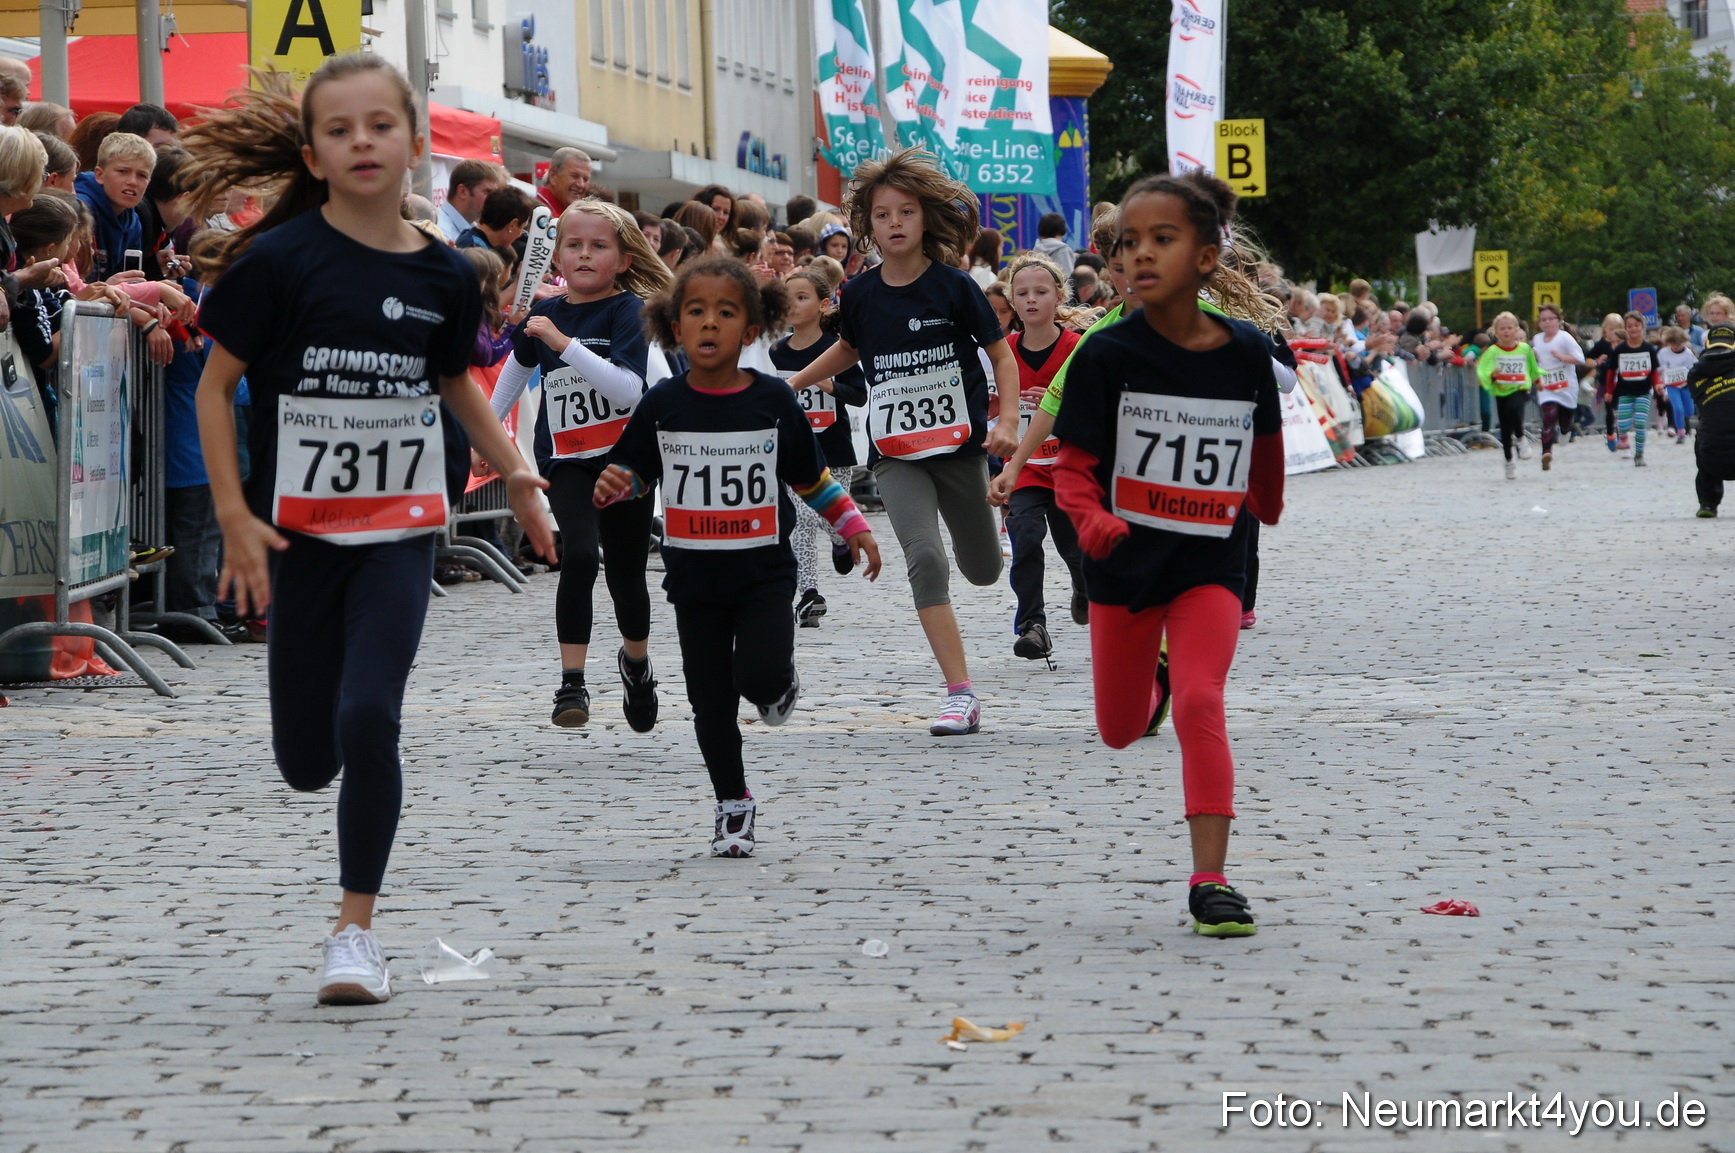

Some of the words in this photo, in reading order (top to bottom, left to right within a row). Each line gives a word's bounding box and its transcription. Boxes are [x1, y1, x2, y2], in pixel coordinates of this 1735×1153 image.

[275, 0, 336, 56] A
[968, 75, 1033, 92] reinigung
[968, 92, 987, 102] ice
[1219, 123, 1259, 137] Block
[1228, 144, 1252, 179] B
[978, 163, 1034, 184] 6352
[1484, 266, 1499, 287] C
[874, 342, 955, 370] GRUNDSCHULE
[1623, 360, 1648, 371] 7214
[1499, 362, 1524, 374] 7322
[326, 374, 370, 395] Haus
[873, 388, 899, 402] PARTL
[901, 381, 947, 395] Neumarkt
[283, 412, 338, 429] PARTL
[343, 413, 416, 430] Neumarkt
[878, 393, 956, 435] 7333
[1122, 405, 1172, 424] PARTL
[1177, 411, 1240, 428] Neumarkt
[662, 443, 697, 456] PARTL
[700, 443, 760, 456] Neumarkt
[1041, 443, 1058, 456] Ele
[1135, 429, 1243, 487] 7157
[299, 438, 425, 493] 7317
[672, 463, 767, 507] 7156
[1148, 490, 1226, 520] Victoria
[689, 516, 750, 535] Liliana
